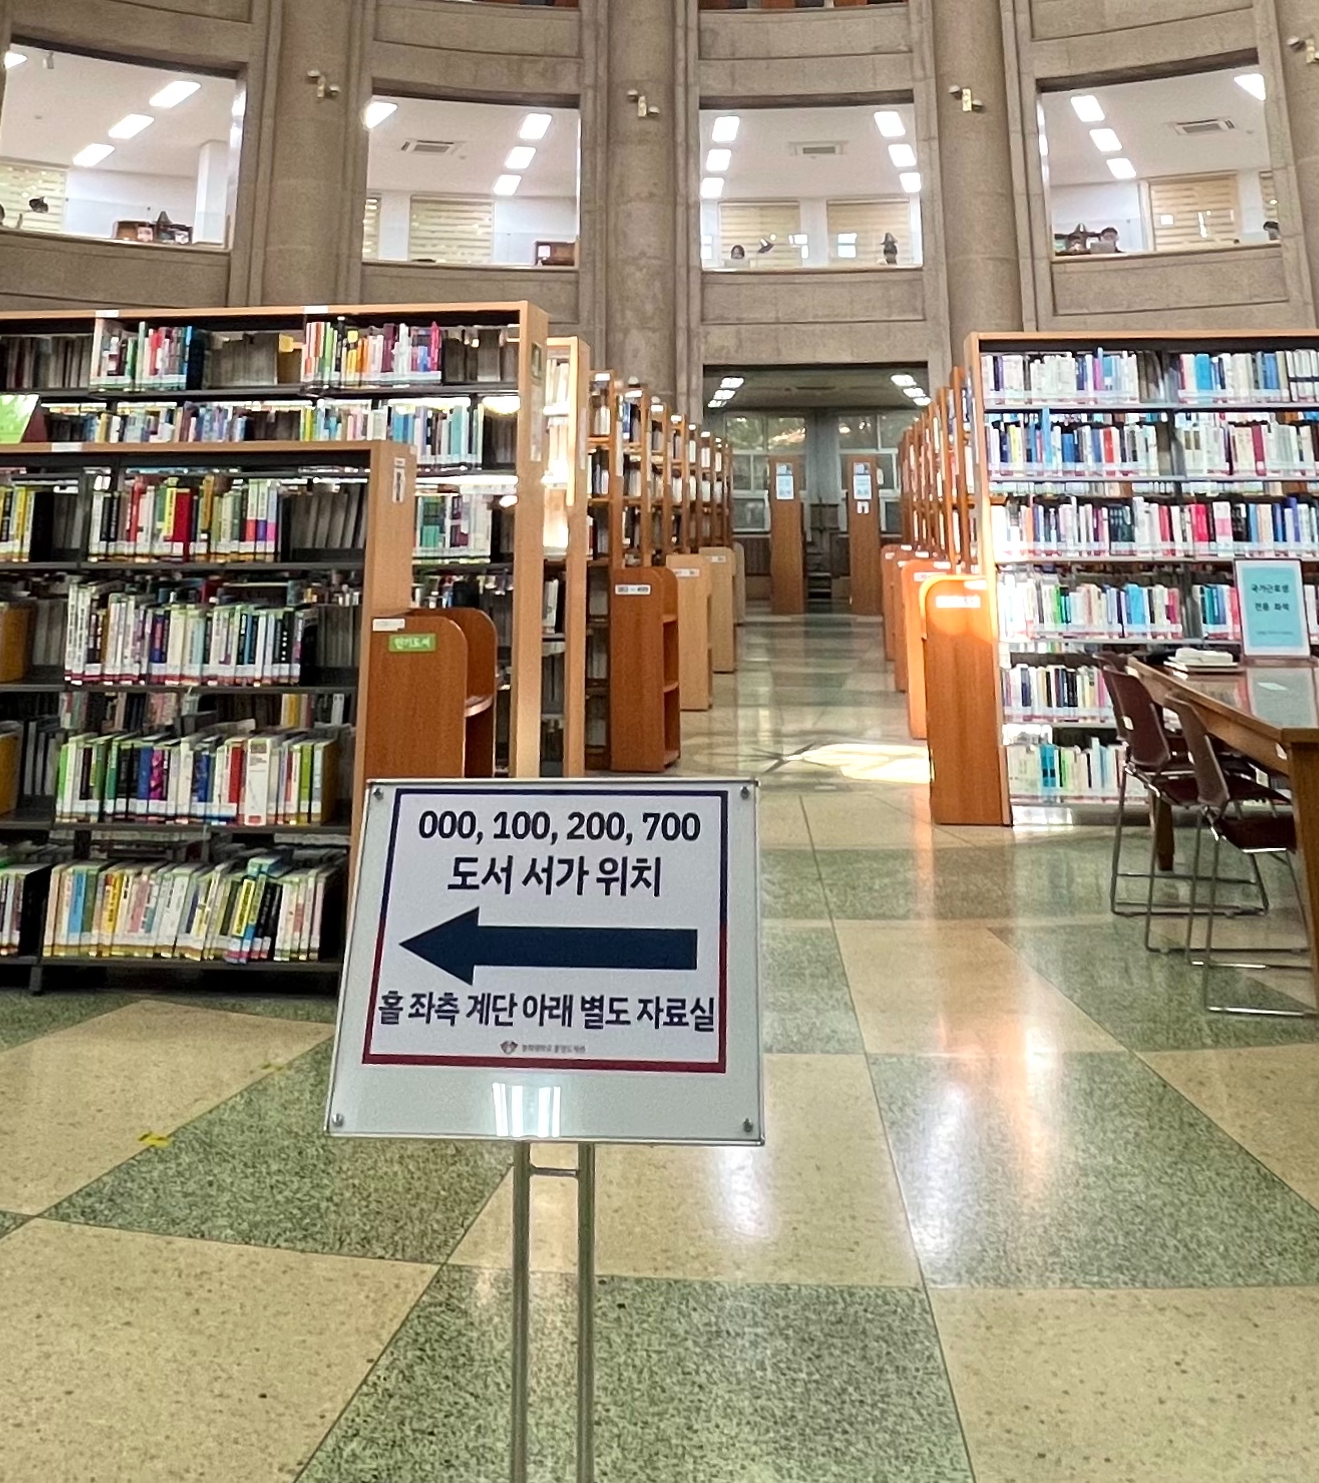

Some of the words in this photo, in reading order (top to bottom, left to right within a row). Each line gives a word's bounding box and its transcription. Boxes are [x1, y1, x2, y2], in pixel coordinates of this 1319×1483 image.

[419, 810, 484, 845] 000,
[493, 811, 559, 846] 100,
[566, 811, 633, 846] 200,
[642, 812, 701, 841] 700
[447, 855, 514, 895] 도서
[522, 856, 590, 896] 서가
[596, 857, 662, 897] 위치
[378, 990, 404, 1025] 홀
[408, 992, 460, 1026] 좌측
[466, 992, 518, 1028] 계단
[522, 993, 573, 1028] 아래
[580, 994, 632, 1030] 별도
[636, 995, 715, 1033] 자료실
